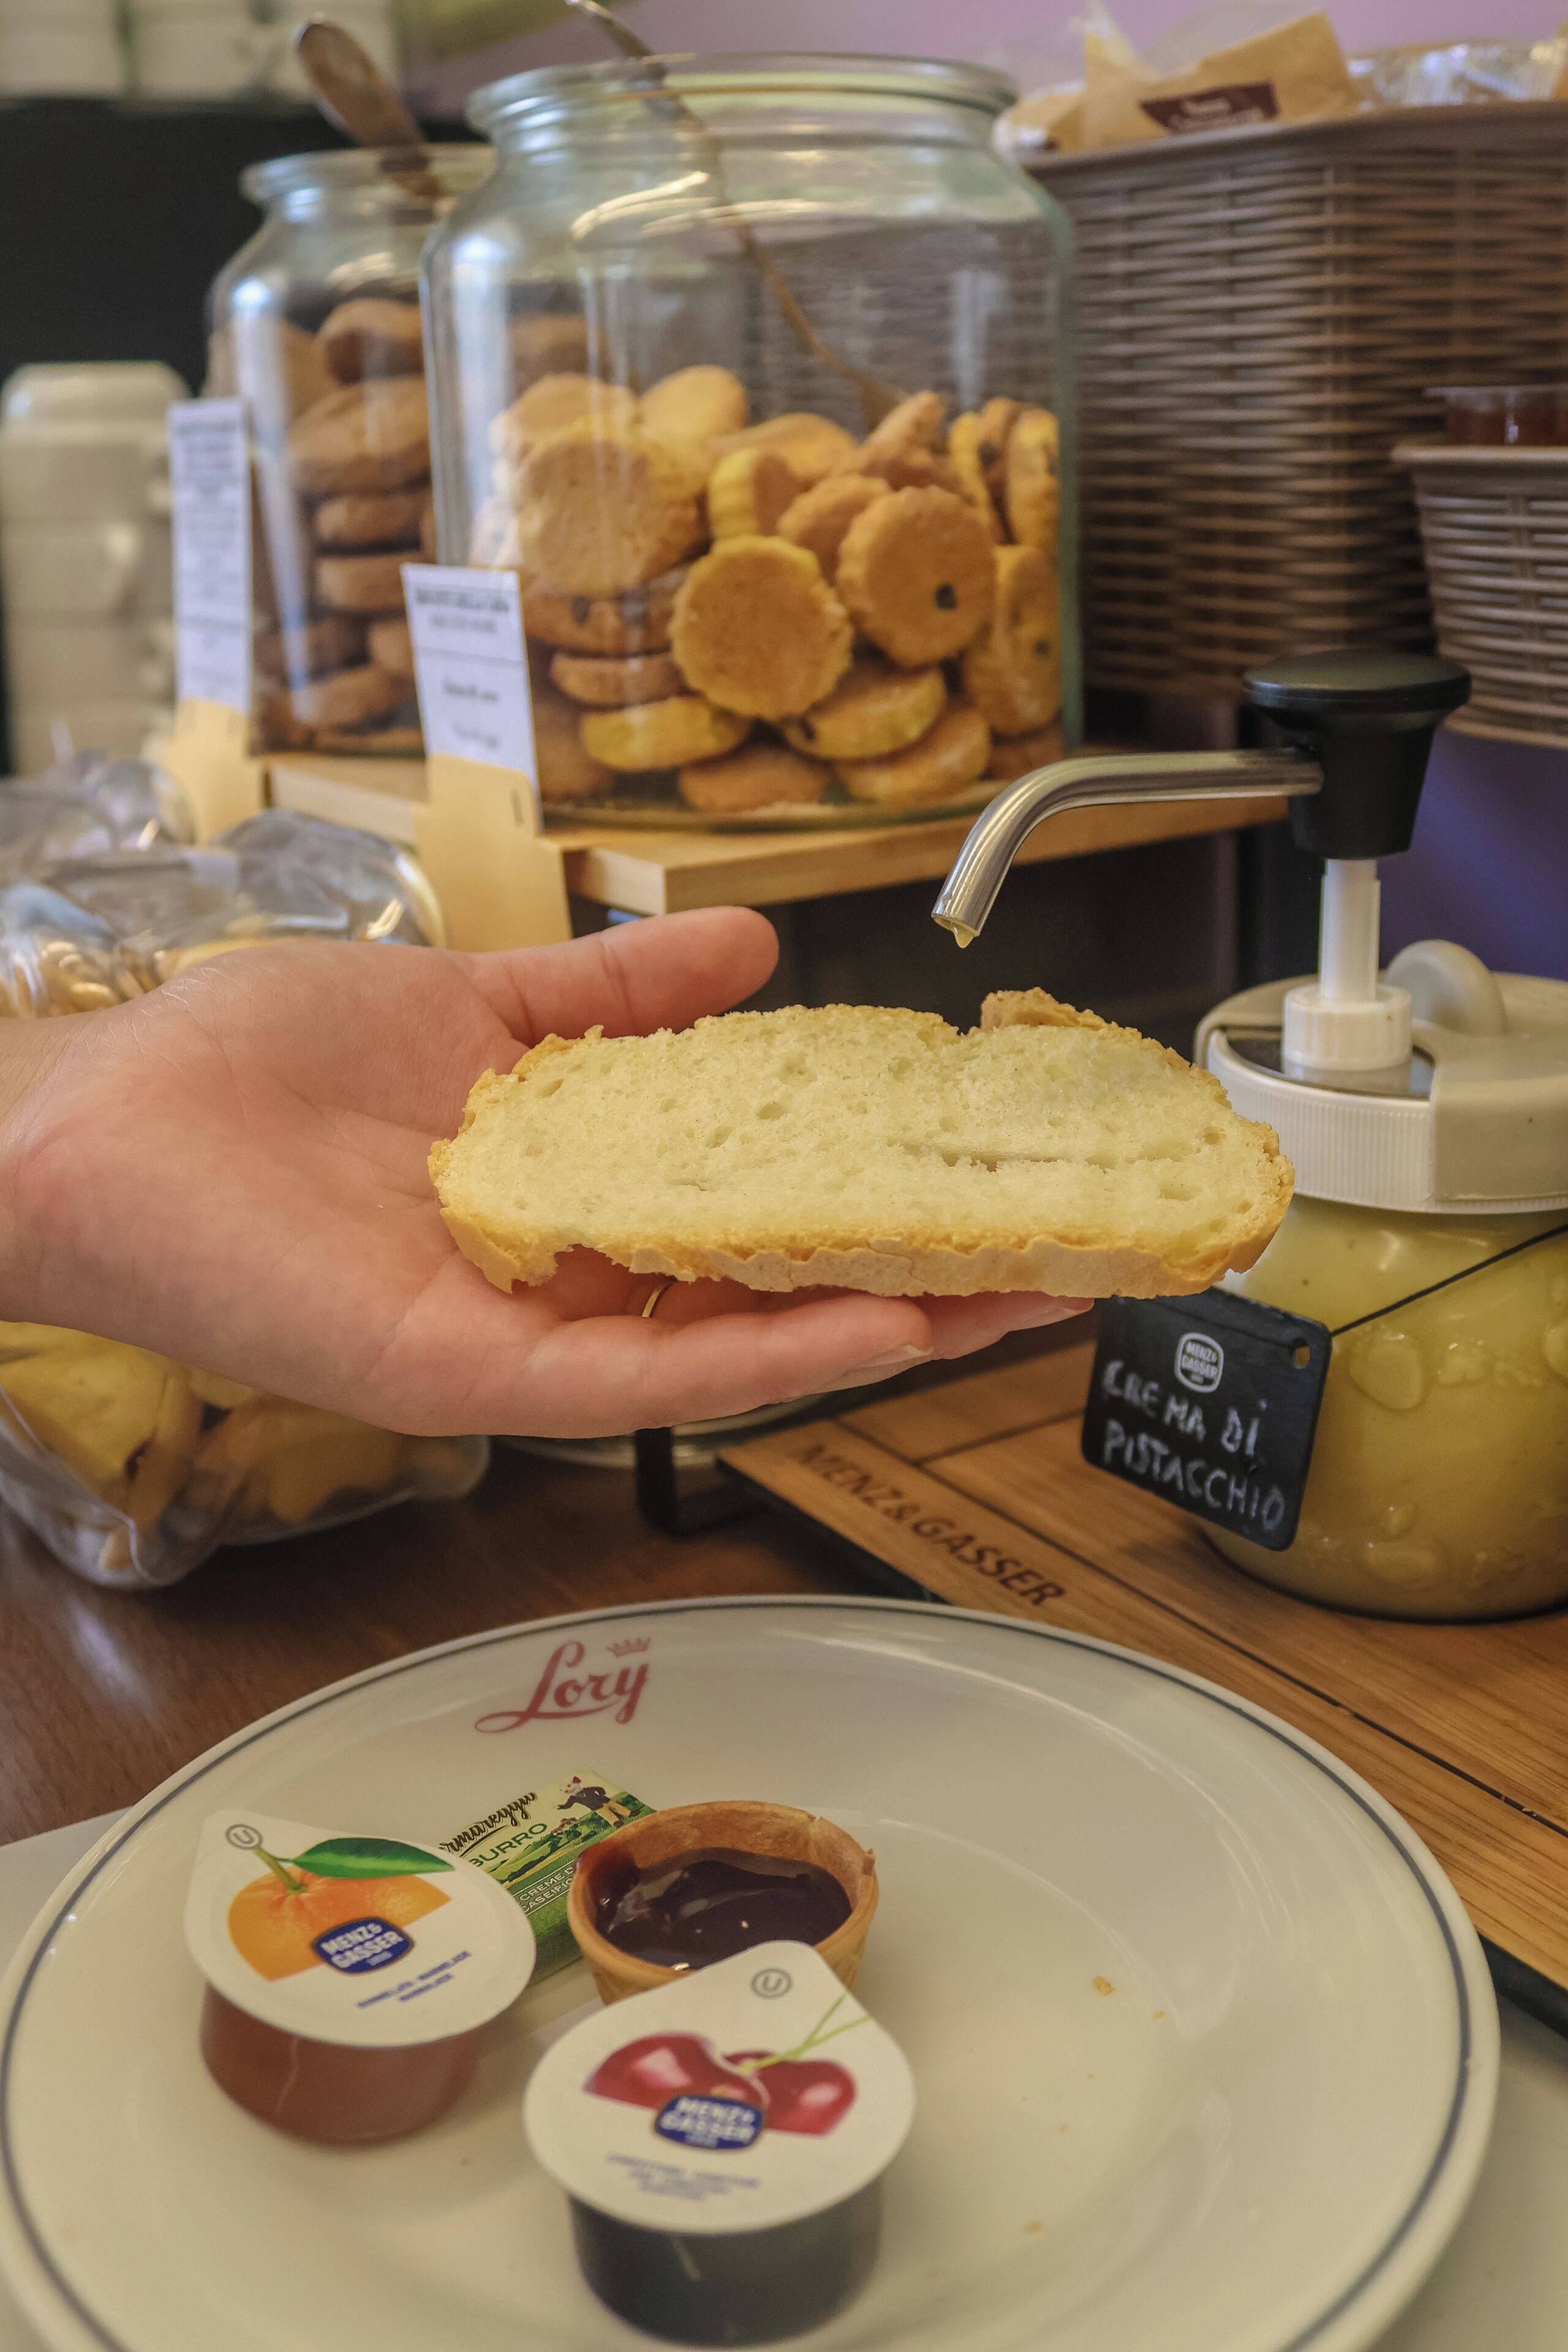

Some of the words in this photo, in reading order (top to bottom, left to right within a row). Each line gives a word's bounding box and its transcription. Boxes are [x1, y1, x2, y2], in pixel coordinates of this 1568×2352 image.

[1181, 1353, 1218, 1380] GASSER
[1102, 1418, 1286, 1531] PISTACCHIO
[474, 1639, 650, 1733] Lory
[469, 1823, 548, 1868] BURRO
[519, 1873, 565, 1901] CREME
[564, 1866, 574, 1875] D
[521, 1877, 573, 1912] CASEIFIC
[331, 1930, 405, 1969] GASSER
